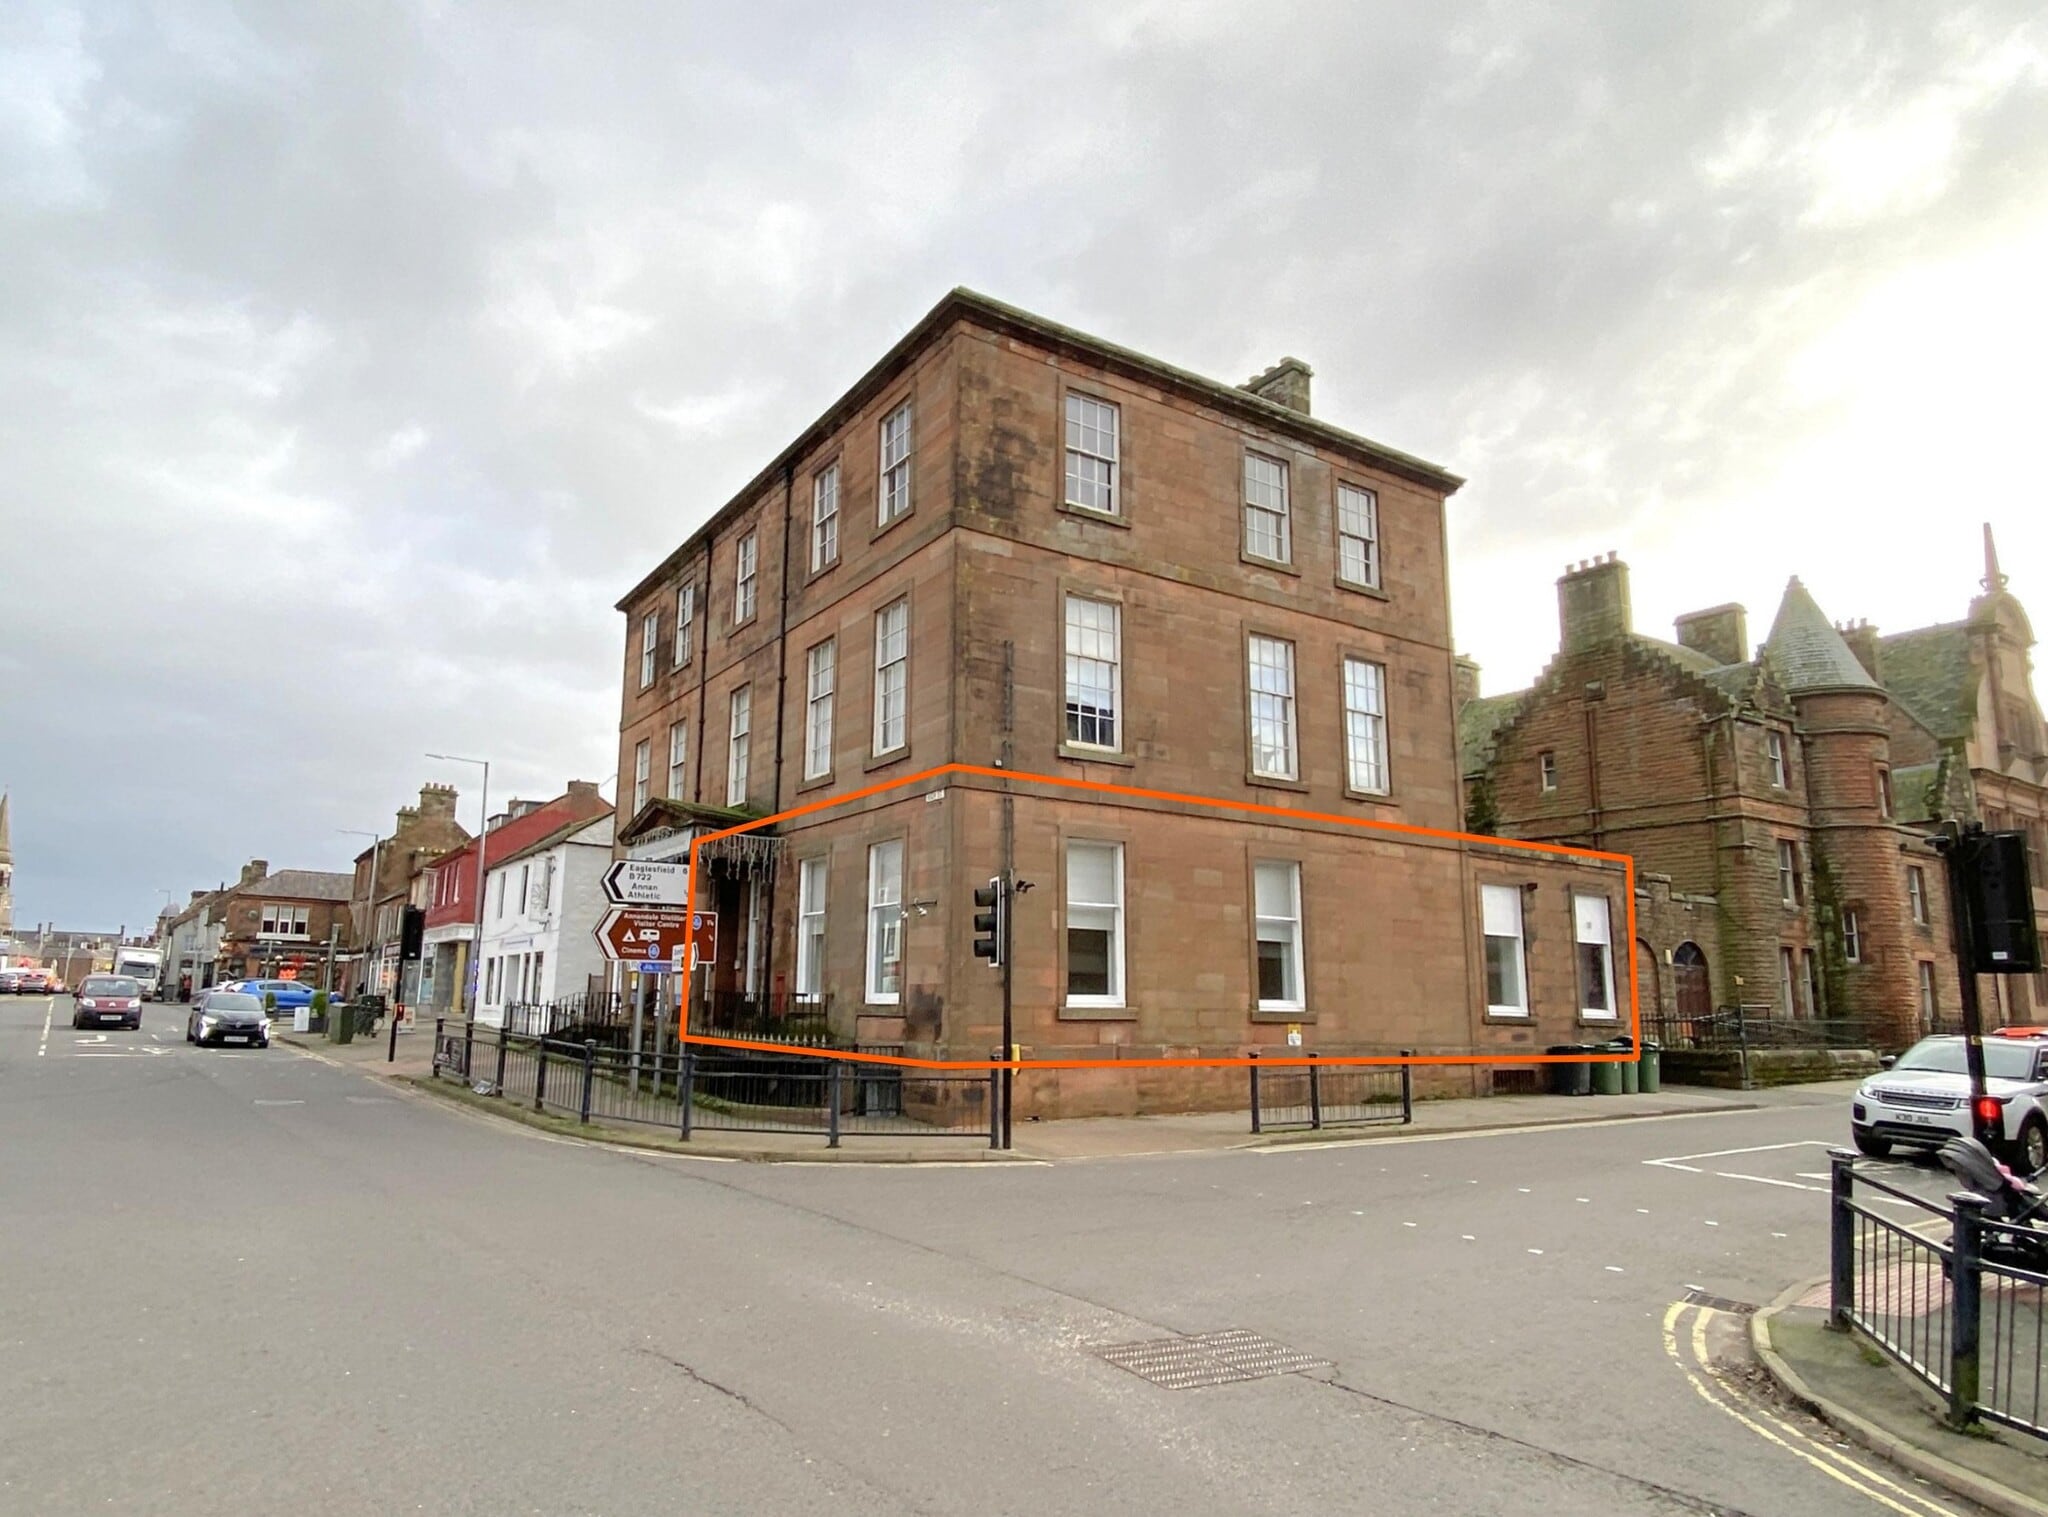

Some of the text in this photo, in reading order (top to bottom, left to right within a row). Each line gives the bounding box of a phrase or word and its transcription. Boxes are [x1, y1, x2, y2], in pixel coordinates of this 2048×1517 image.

[630, 864, 675, 875] Eaglesfield
[631, 882, 658, 891] Annan
[627, 891, 661, 900] Athletic
[624, 912, 687, 922] Annandale Distiller
[622, 946, 646, 954] Cinema
